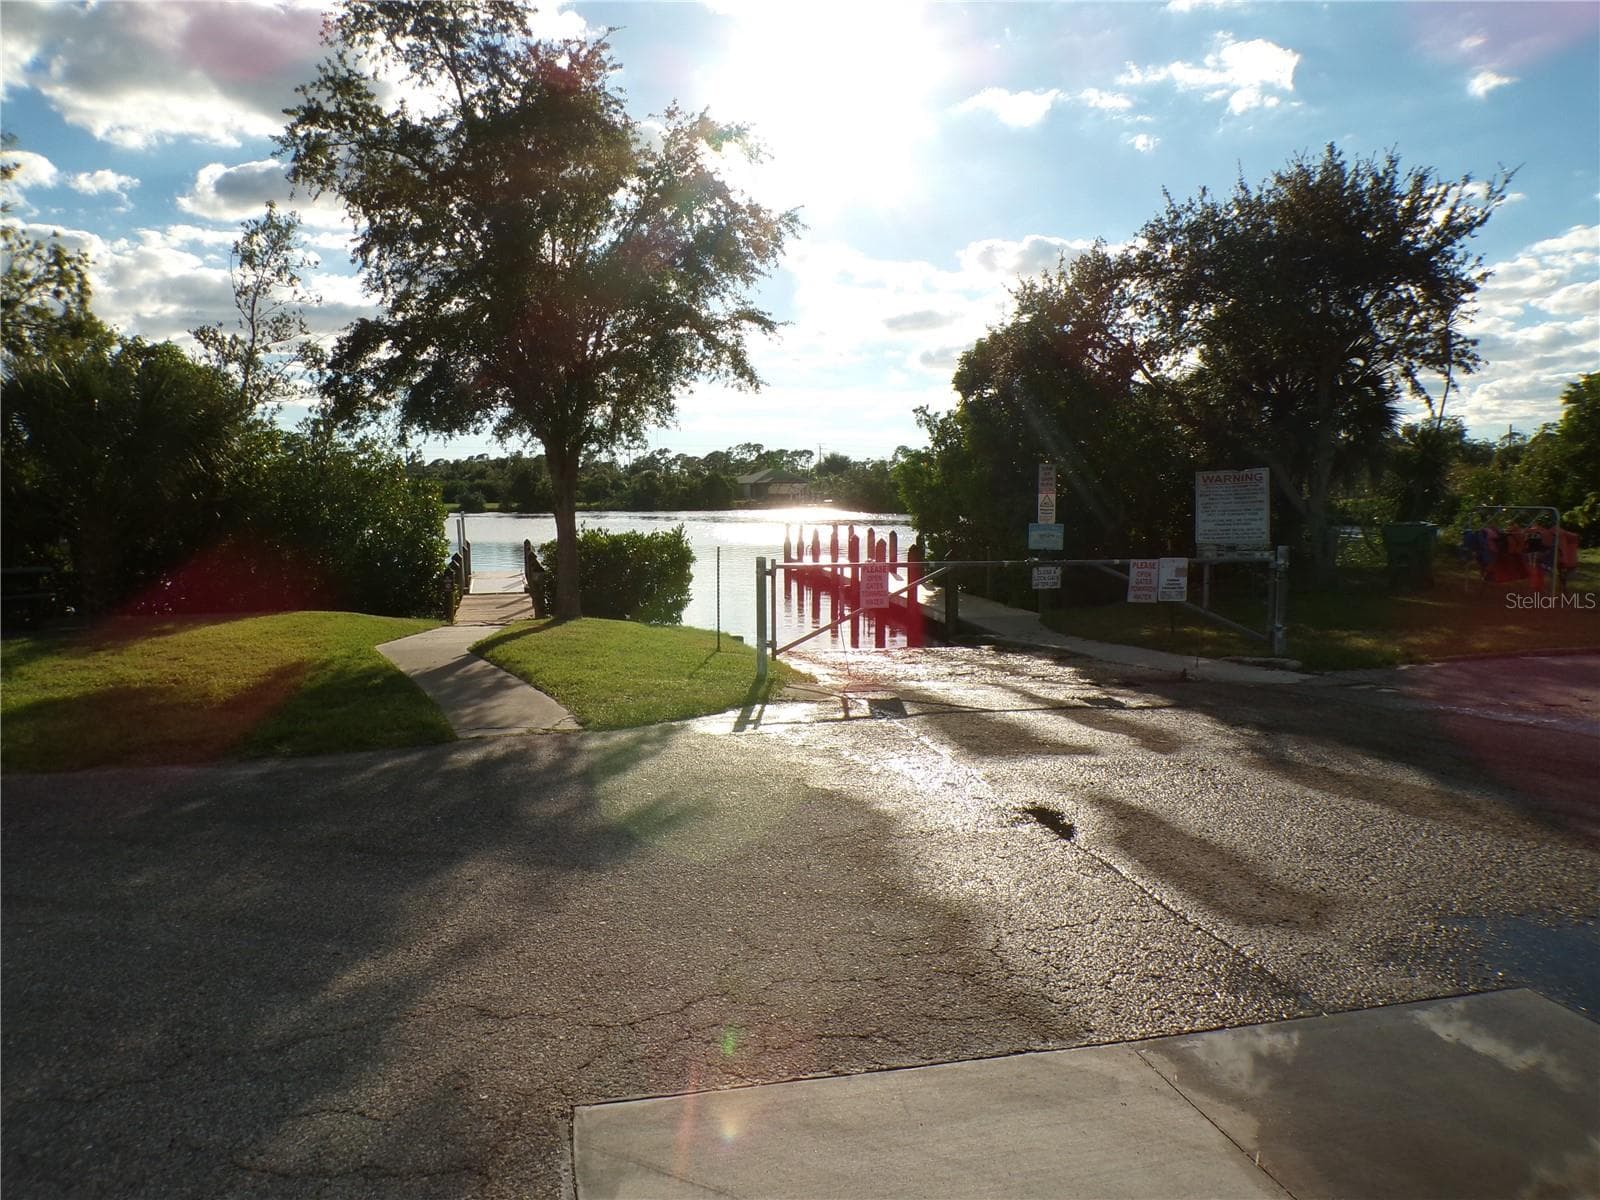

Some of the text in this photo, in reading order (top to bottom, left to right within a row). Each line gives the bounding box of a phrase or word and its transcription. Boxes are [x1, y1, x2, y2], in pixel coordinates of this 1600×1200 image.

[1201, 472, 1264, 484] WARNING
[863, 565, 888, 573] PLEASE
[1132, 561, 1157, 569] PLEASE
